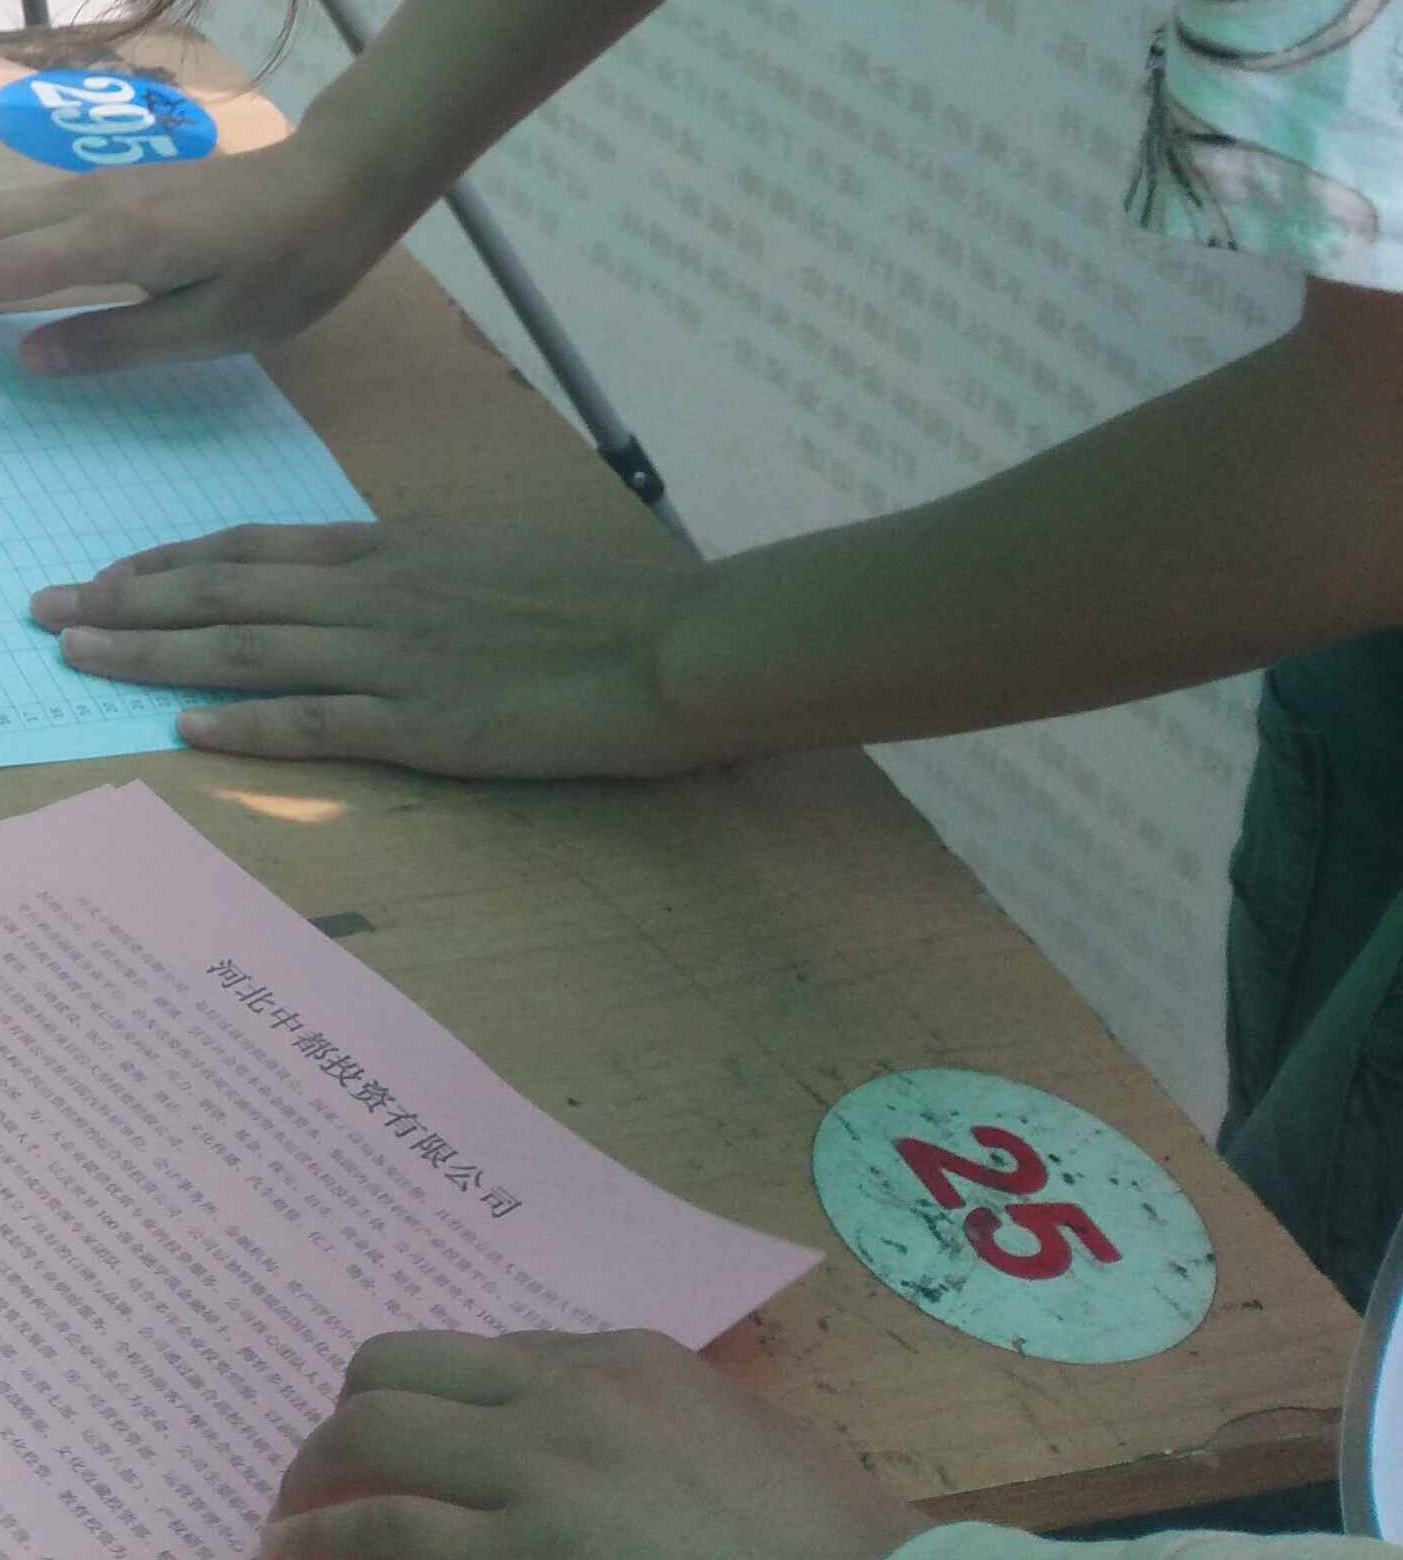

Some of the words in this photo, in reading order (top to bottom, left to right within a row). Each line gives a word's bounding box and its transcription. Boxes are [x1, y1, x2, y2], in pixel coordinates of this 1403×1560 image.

[30, 76, 178, 164] 295
[206, 958, 523, 1218] 河北中都投资有限公司
[895, 1125, 1123, 1279] 25
